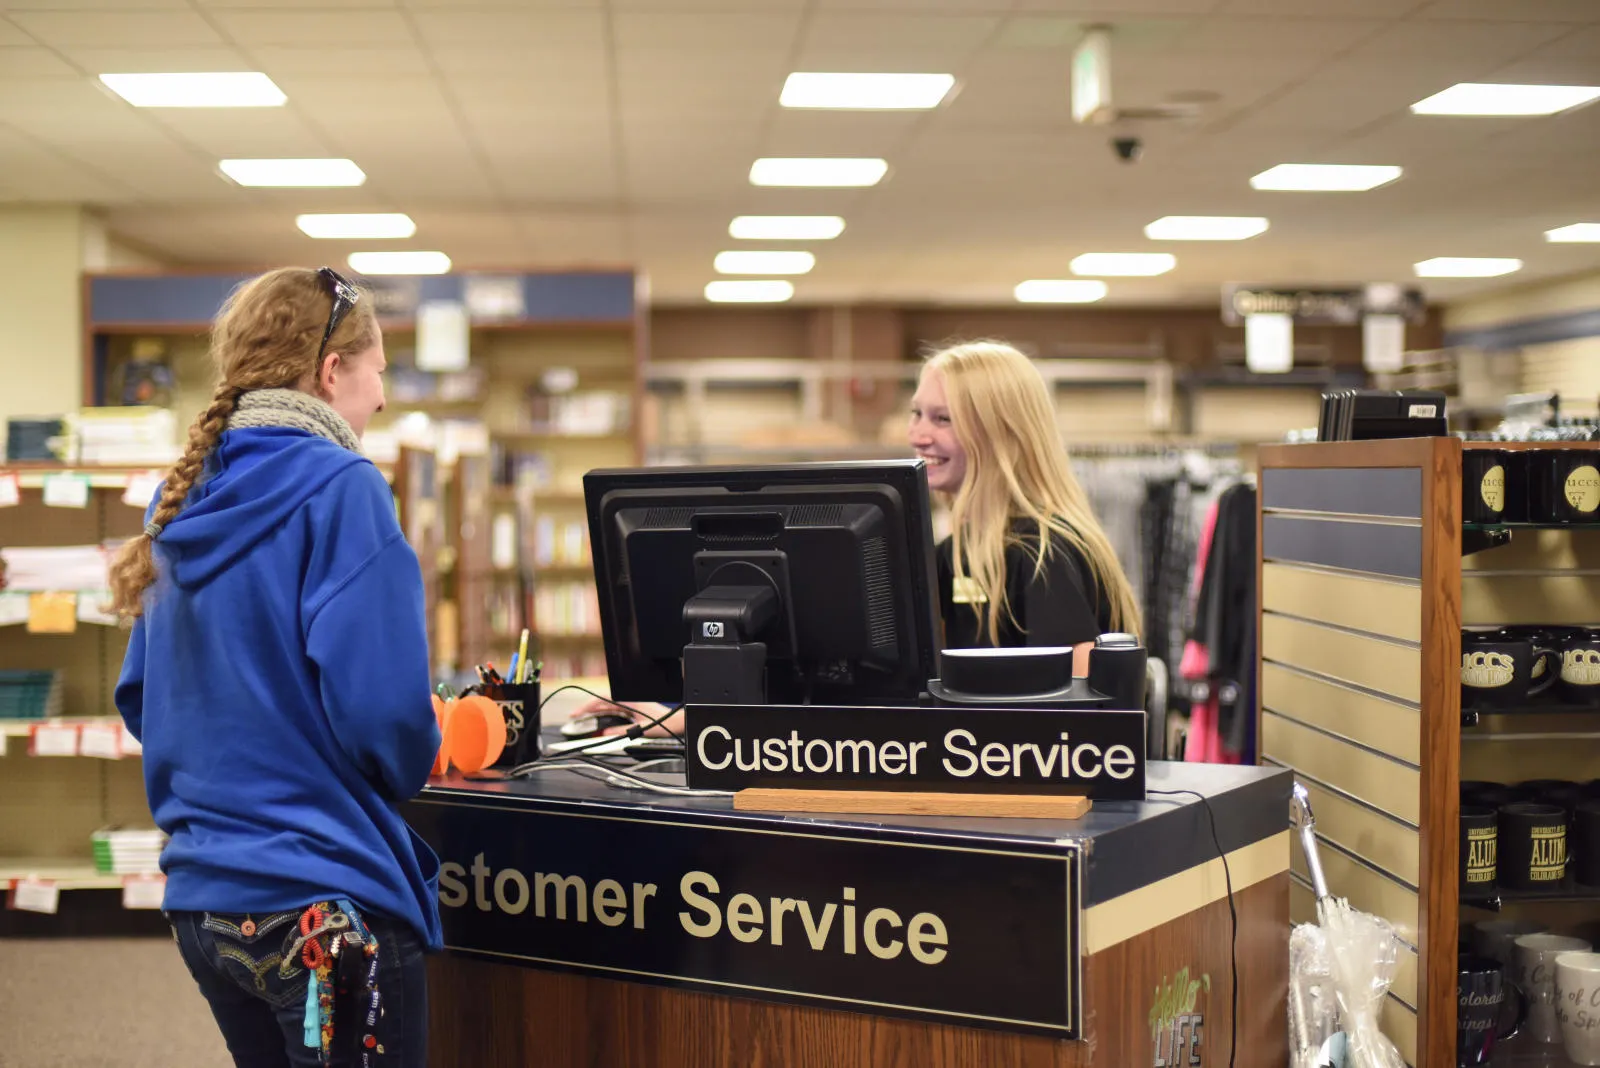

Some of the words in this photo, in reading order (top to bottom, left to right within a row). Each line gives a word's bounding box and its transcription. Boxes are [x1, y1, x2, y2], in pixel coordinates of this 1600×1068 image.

[497, 700, 525, 729] CS
[697, 725, 927, 775] Customer
[942, 728, 1136, 779] Service
[438, 852, 658, 930] stomer
[678, 870, 949, 965] Service
[1568, 988, 1585, 1006] of
[1154, 1015, 1204, 1068] LIFE
